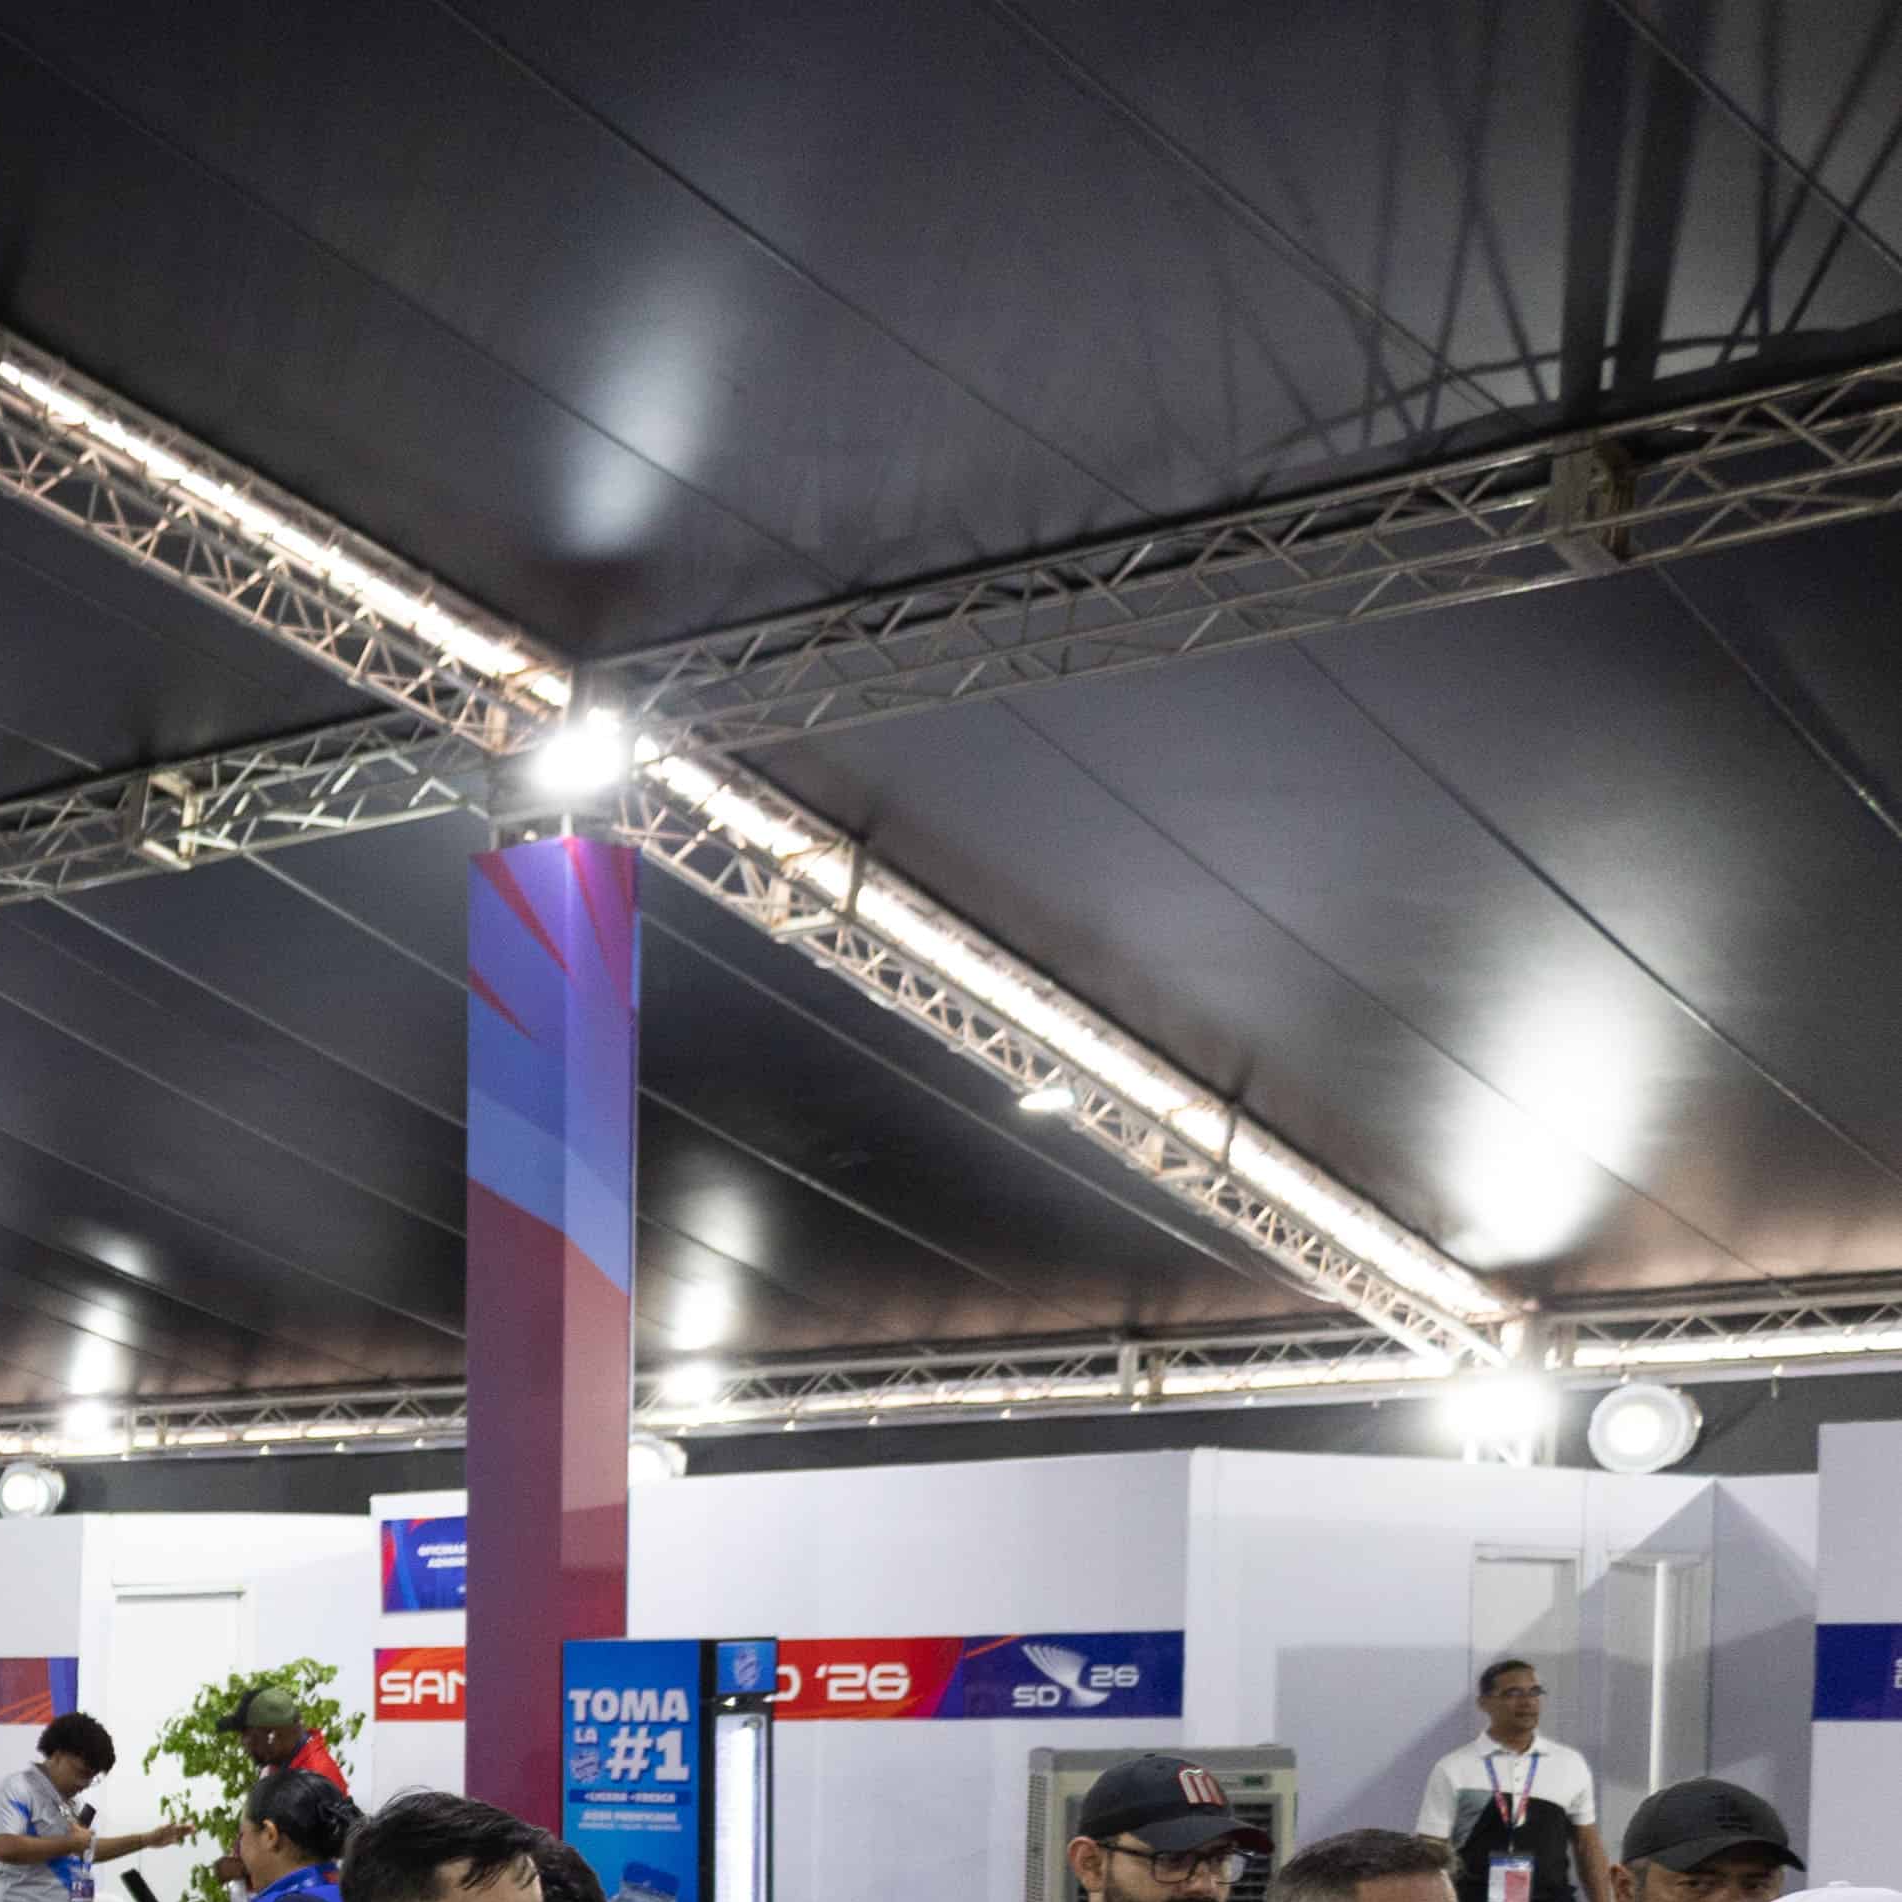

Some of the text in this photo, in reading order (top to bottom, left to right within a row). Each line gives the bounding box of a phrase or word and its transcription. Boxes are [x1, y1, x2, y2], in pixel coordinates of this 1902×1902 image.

[380, 1671, 467, 1705] SAN
[815, 1663, 912, 1701] '26
[1089, 1664, 1141, 1689] 26
[568, 1688, 690, 1723] TOMA
[1012, 1685, 1061, 1707] SD
[574, 1727, 598, 1744] LA
[606, 1726, 690, 1781] #1
